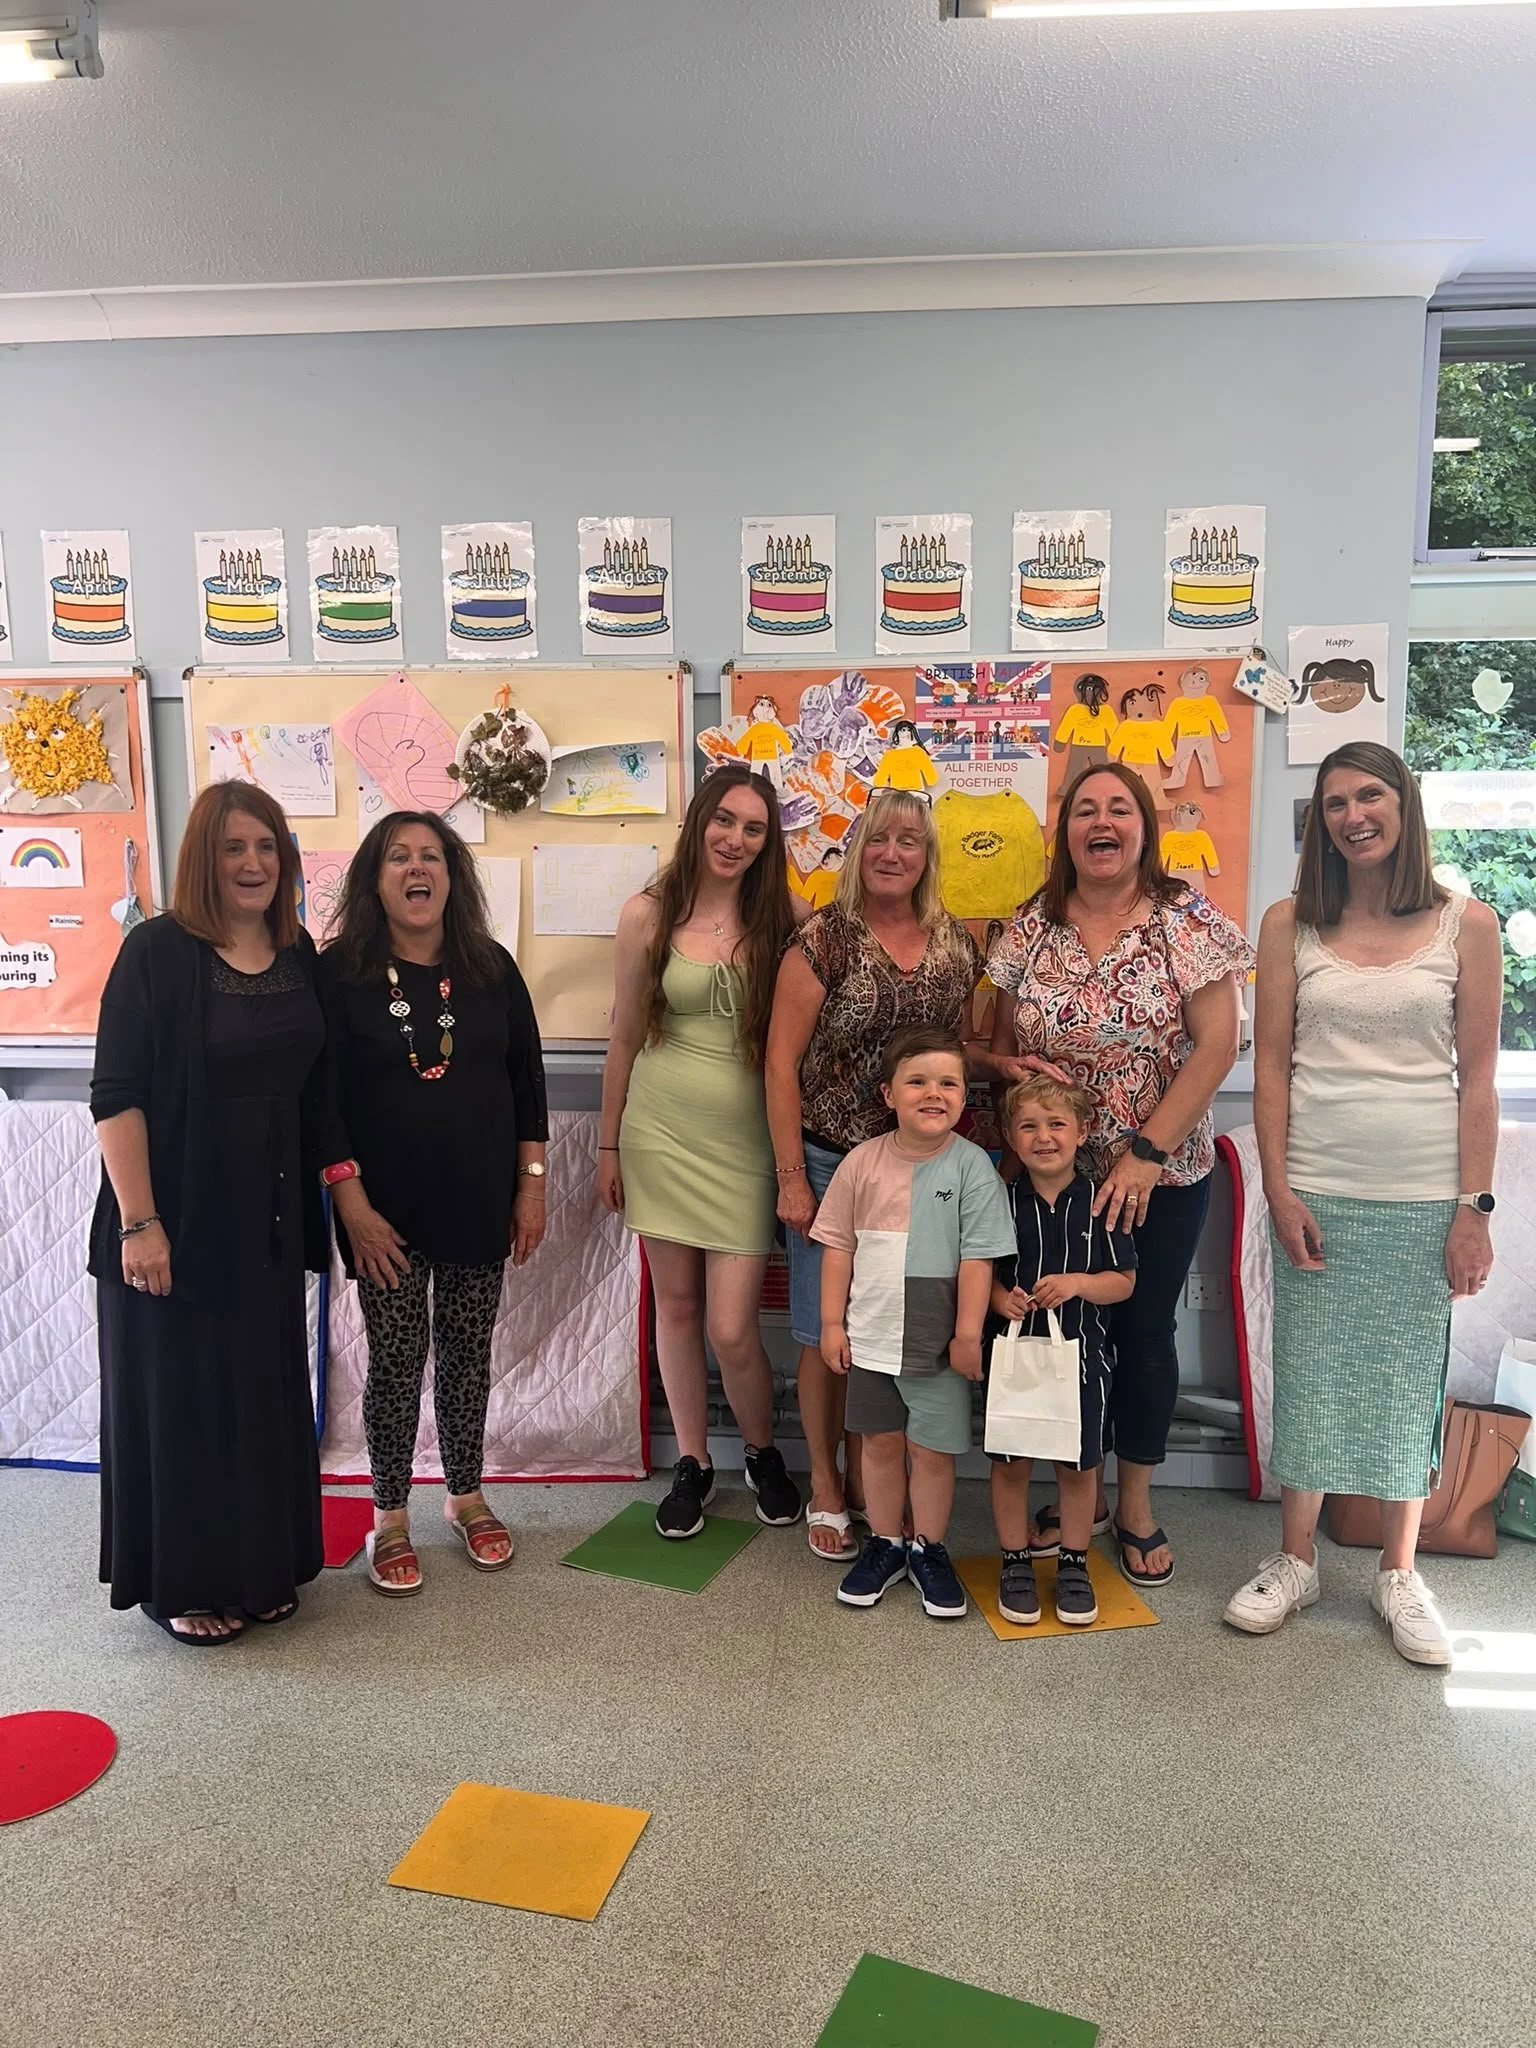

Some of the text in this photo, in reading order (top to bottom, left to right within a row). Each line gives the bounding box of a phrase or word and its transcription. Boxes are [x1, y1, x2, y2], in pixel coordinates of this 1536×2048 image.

[894, 565, 961, 581] October
[1027, 564, 1105, 578] November
[1180, 560, 1257, 575] December
[338, 576, 380, 592] June
[473, 572, 513, 594] July
[598, 568, 664, 590] August
[755, 569, 832, 587] September
[72, 578, 113, 599] April
[227, 578, 266, 599] May
[1325, 638, 1354, 648] Happy
[925, 666, 1044, 680] BRITISH VALUES
[944, 762, 1018, 773] ALL FRIENDS
[950, 778, 1013, 787] TOGETHER
[961, 830, 1004, 845] Badger Farm
[1175, 862, 1194, 870] James
[33, 951, 49, 962] its
[0, 970, 37, 984] uring
